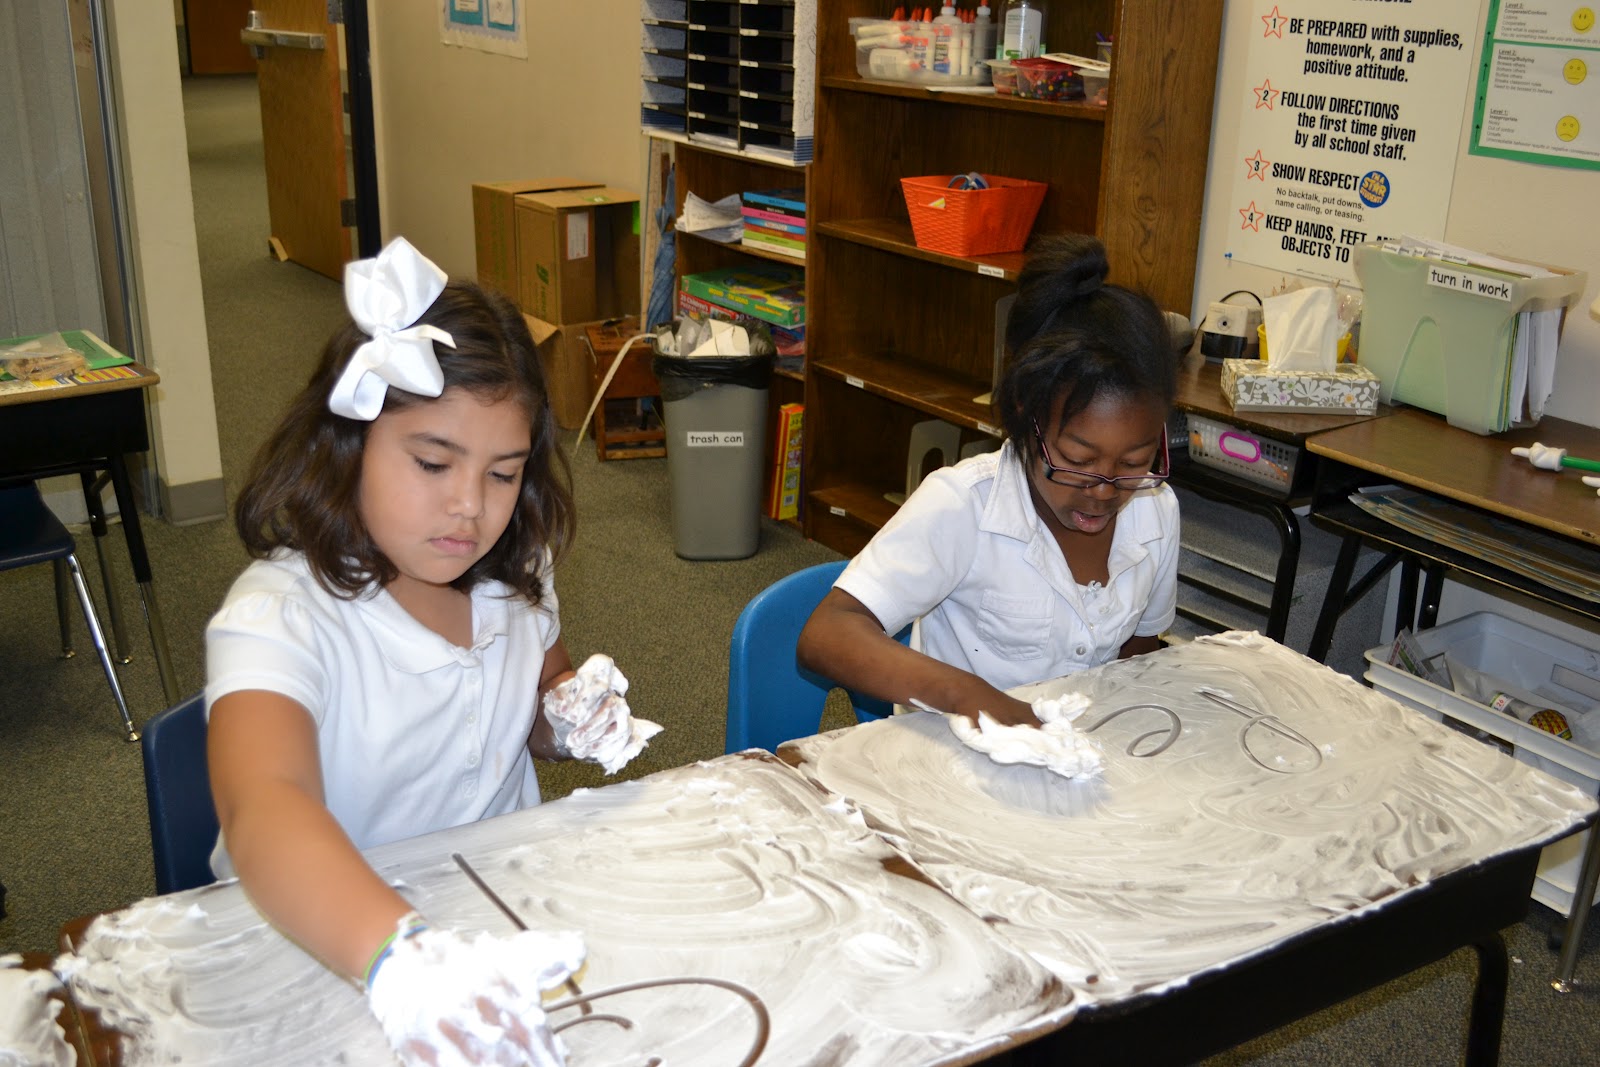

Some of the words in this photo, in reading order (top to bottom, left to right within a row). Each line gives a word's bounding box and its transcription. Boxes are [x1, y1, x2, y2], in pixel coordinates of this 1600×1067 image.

[1272, 18, 1277, 29] 1
[1290, 18, 1304, 34] BE
[1307, 20, 1367, 39] PREPARED
[1371, 25, 1400, 42] with
[1403, 29, 1463, 50] supplies,
[1306, 38, 1375, 62] homework,
[1380, 46, 1403, 62] and
[1407, 50, 1415, 63] a
[1303, 59, 1351, 77] positive
[1355, 63, 1408, 83] attitude.
[1263, 90, 1269, 101] 2
[1281, 91, 1326, 110] FOLLOW
[1329, 97, 1399, 121] DIRECTIONS
[1297, 112, 1316, 128] the
[1319, 115, 1347, 132] first
[1350, 119, 1377, 137] time
[1381, 124, 1416, 142] given
[1294, 130, 1308, 148] by
[1312, 133, 1326, 148] all
[1329, 137, 1370, 155] school
[1373, 144, 1406, 161] staff.
[1254, 160, 1260, 172] 3
[1272, 162, 1306, 182] SHOW
[1308, 168, 1360, 191] RESPECT
[1275, 200, 1294, 208] name
[1296, 203, 1322, 214] calling,
[1335, 209, 1364, 222] teasing.
[1276, 187, 1286, 196] No
[1288, 190, 1320, 202] backtalk,
[1336, 198, 1364, 210] downs,
[1248, 212, 1254, 223] 4
[1266, 214, 1292, 232] KEEP
[1295, 220, 1336, 244] HANDS,
[1281, 235, 1331, 259] OBJECTS
[1336, 246, 1350, 263] TO
[1431, 270, 1456, 286] turn
[1462, 276, 1472, 290] in
[1478, 284, 1508, 298] work
[691, 434, 719, 443] trash
